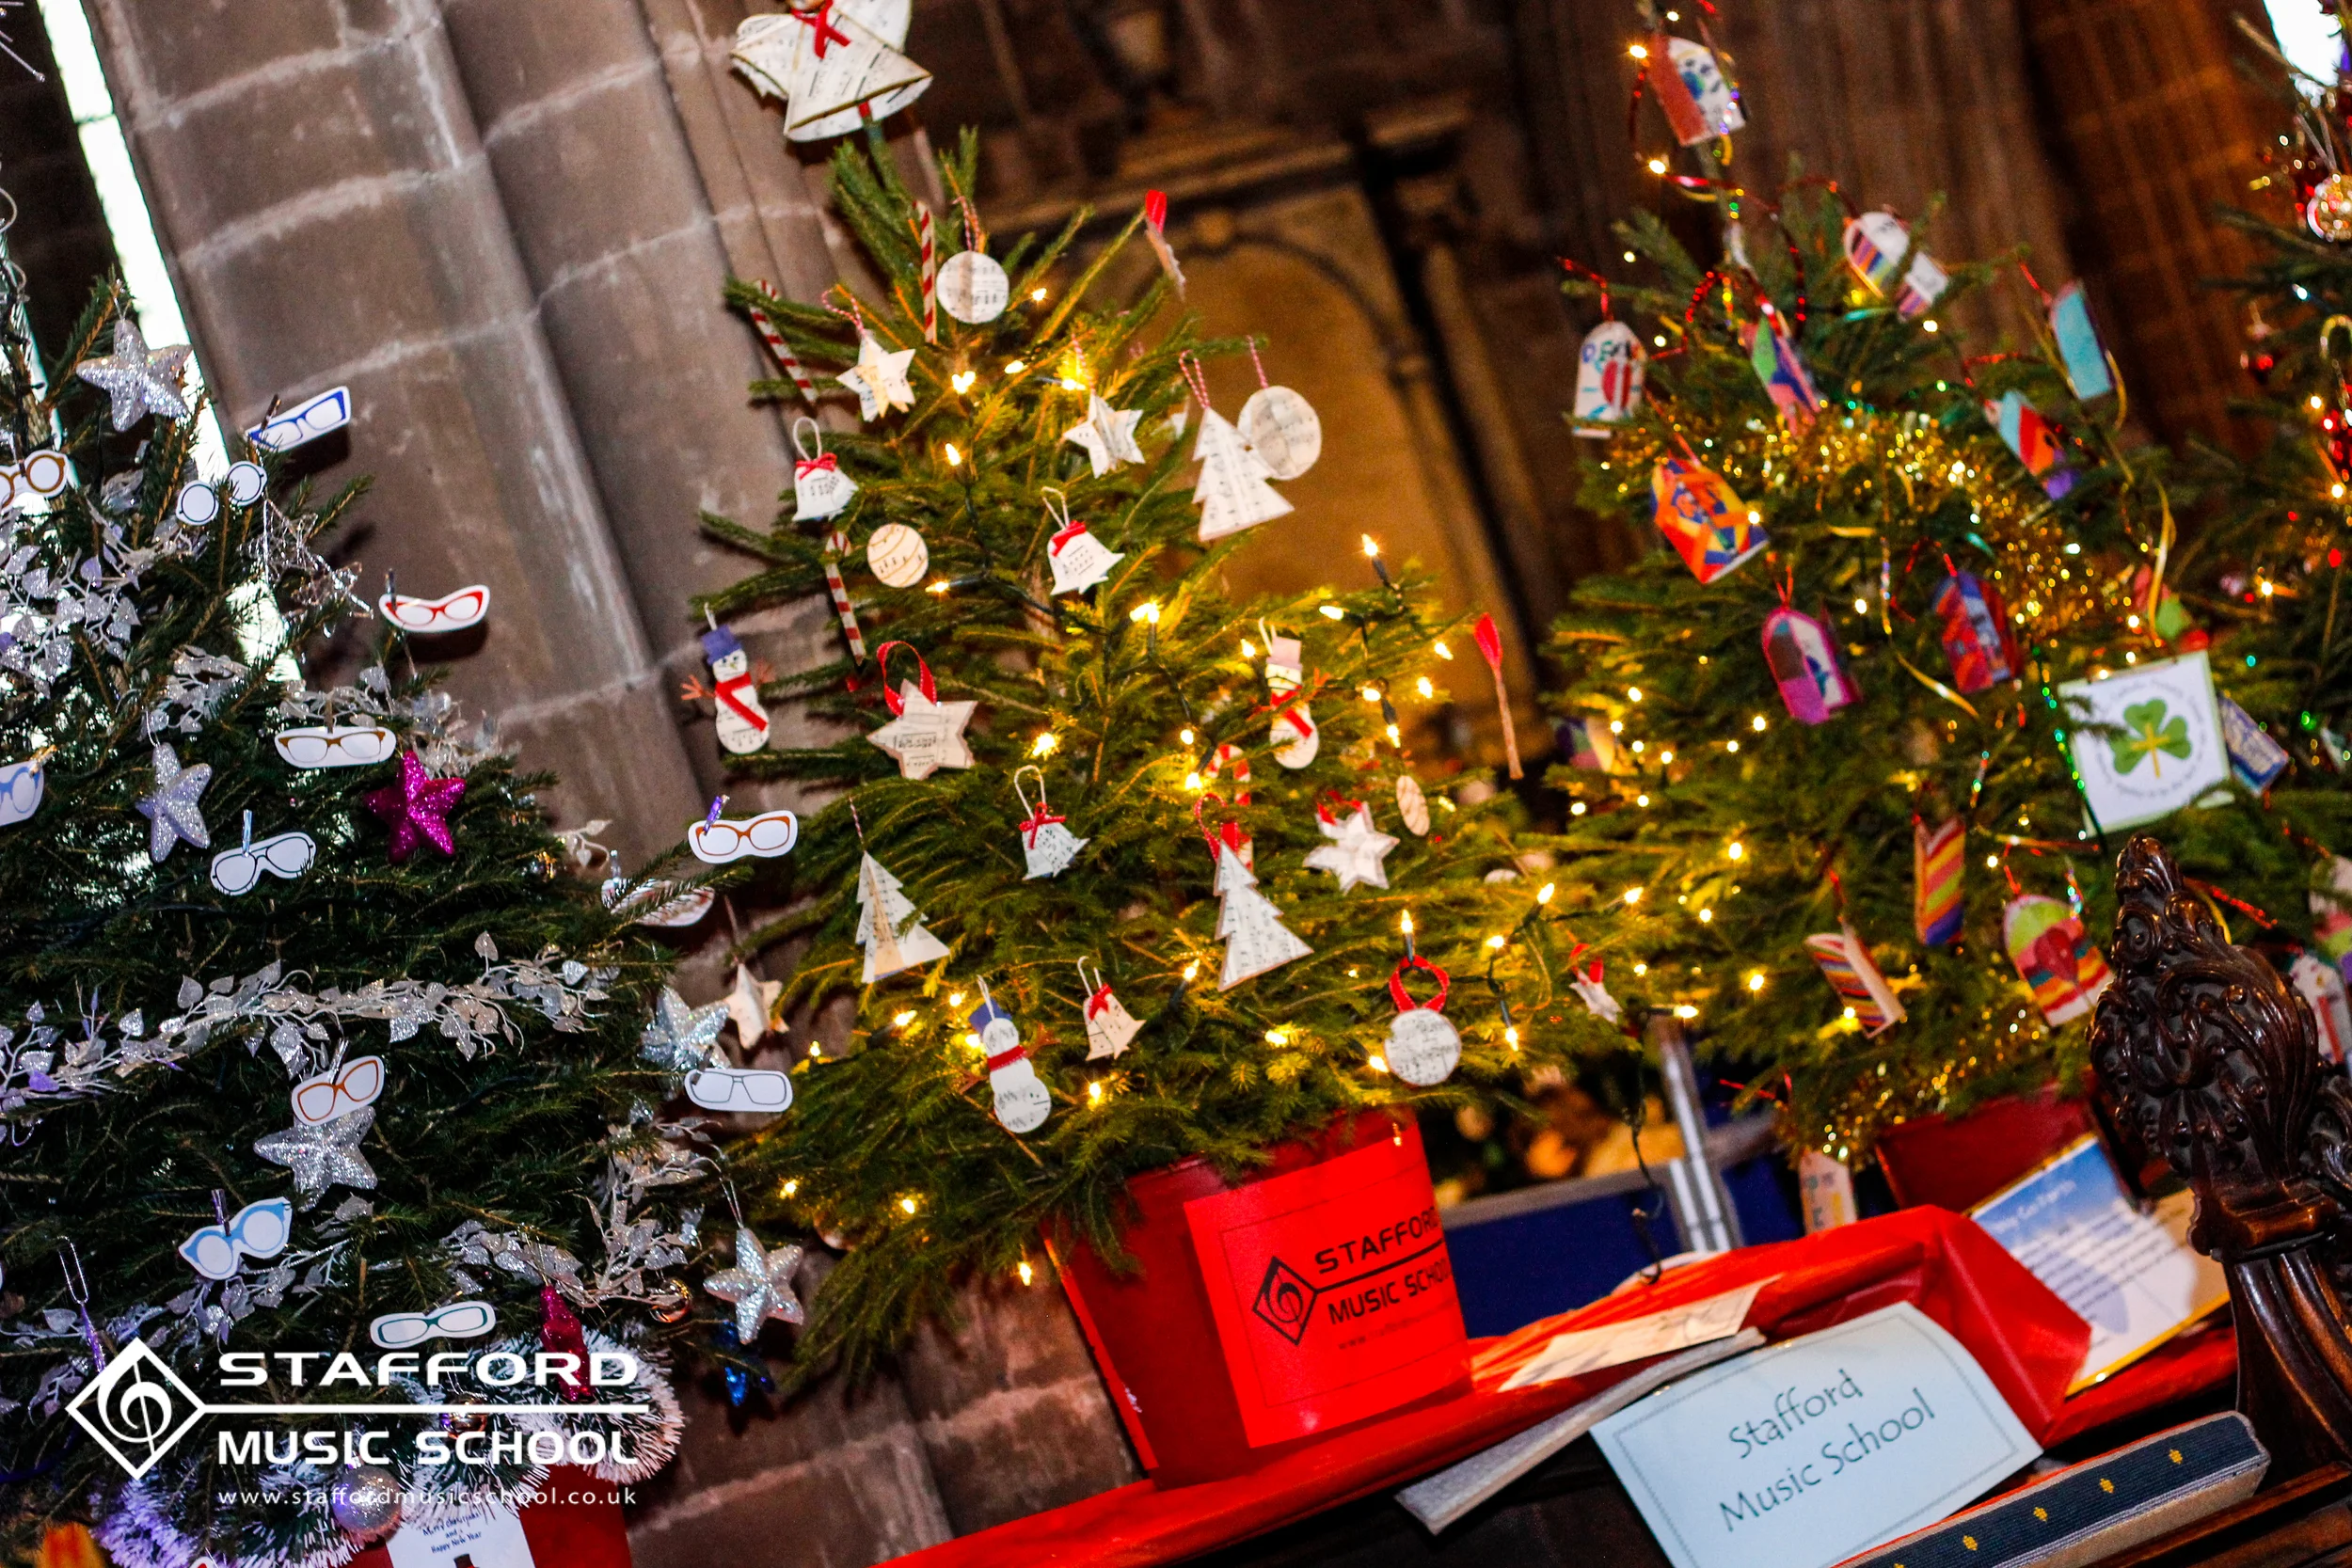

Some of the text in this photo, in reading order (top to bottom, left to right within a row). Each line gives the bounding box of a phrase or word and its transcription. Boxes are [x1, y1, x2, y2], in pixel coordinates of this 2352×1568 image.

[1327, 1280, 1401, 1325] MUSIC
[1728, 1368, 1863, 1459] Stafford
[1719, 1386, 1935, 1532] Music School
[431, 1543, 451, 1554] Happy
[467, 1531, 482, 1541] Year
